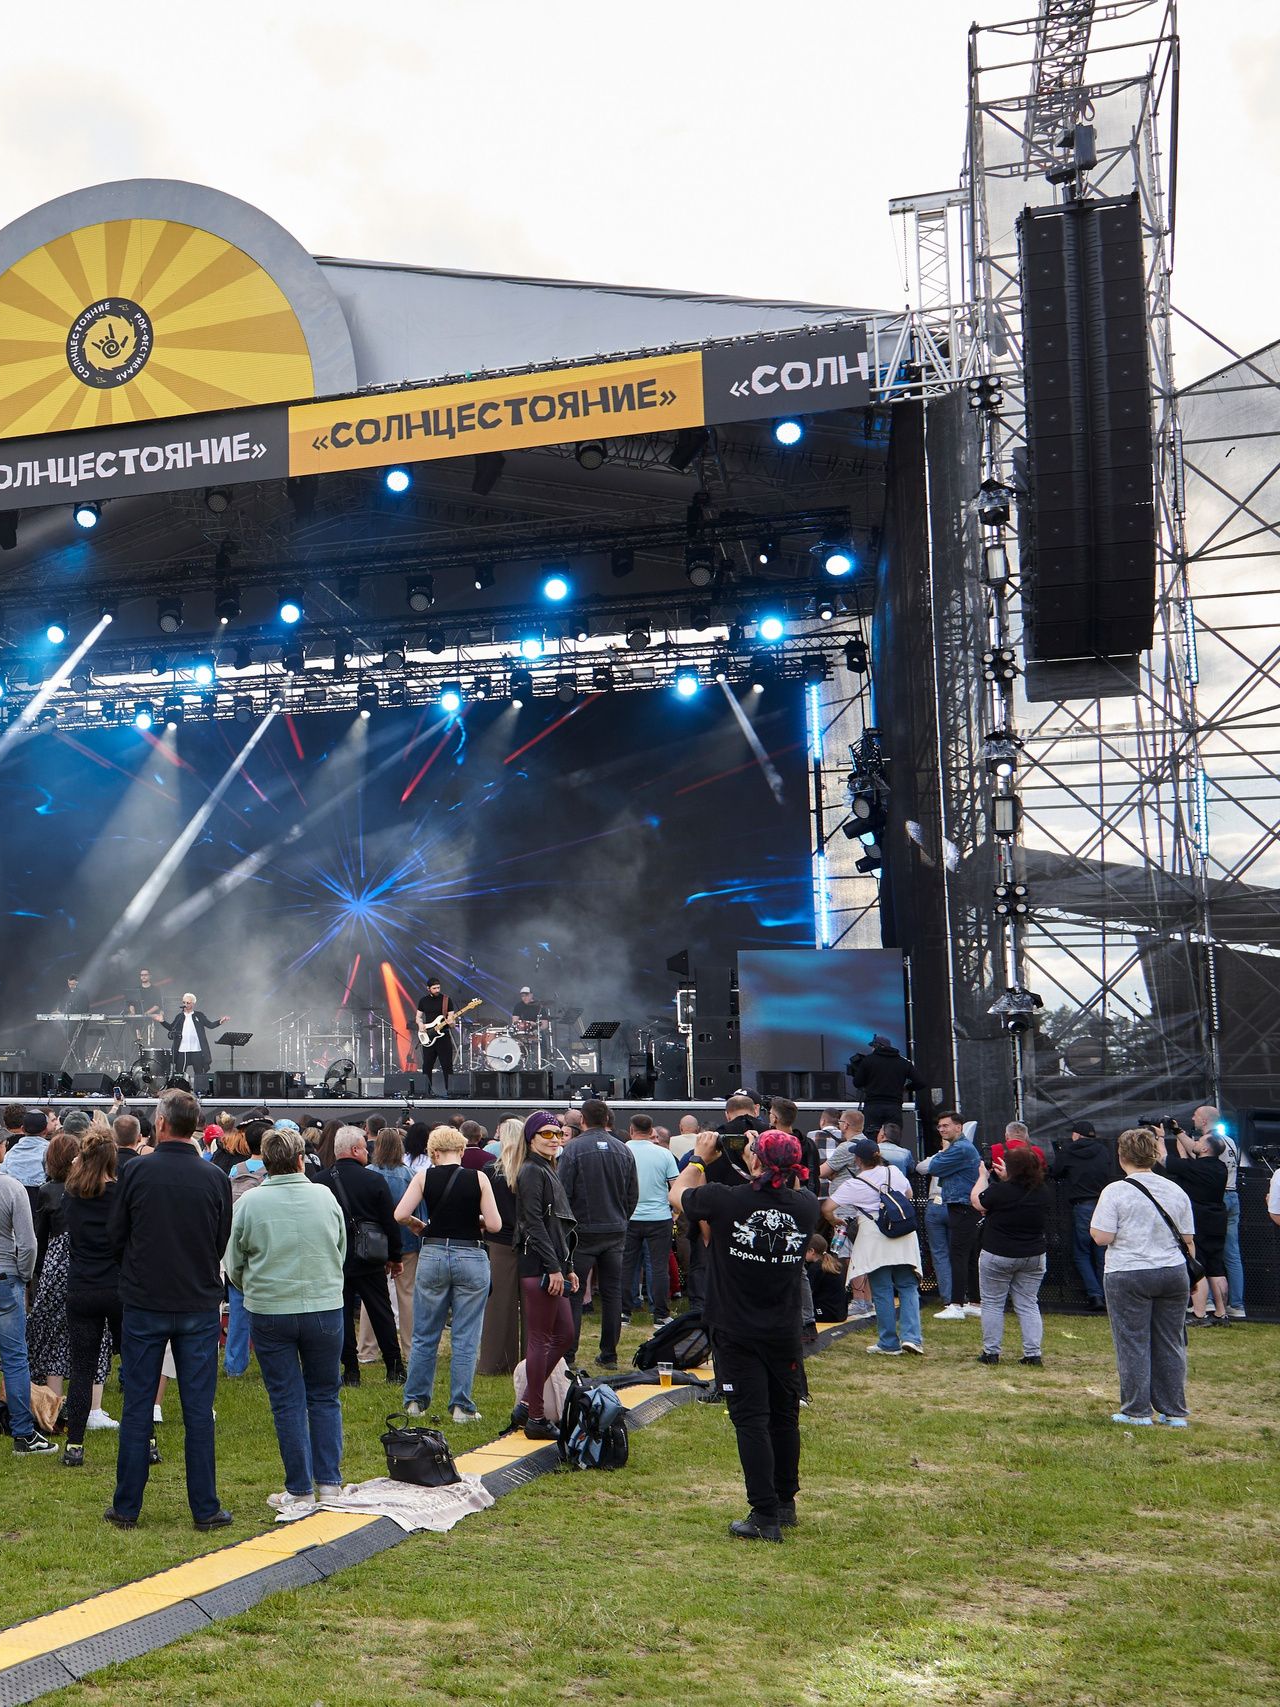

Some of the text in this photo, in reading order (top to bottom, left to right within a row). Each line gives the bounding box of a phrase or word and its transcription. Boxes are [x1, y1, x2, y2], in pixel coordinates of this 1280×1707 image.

[70, 302, 110, 378] СОЛНЦЕСТОЯНИЕ
[116, 313, 150, 382] РОК-ФЕСТИВАЛЬ
[312, 379, 677, 451] «СОЛНЦЕСТОЯНИЕ»
[729, 1246, 766, 1263] Король
[781, 1254, 802, 1264] Шут
